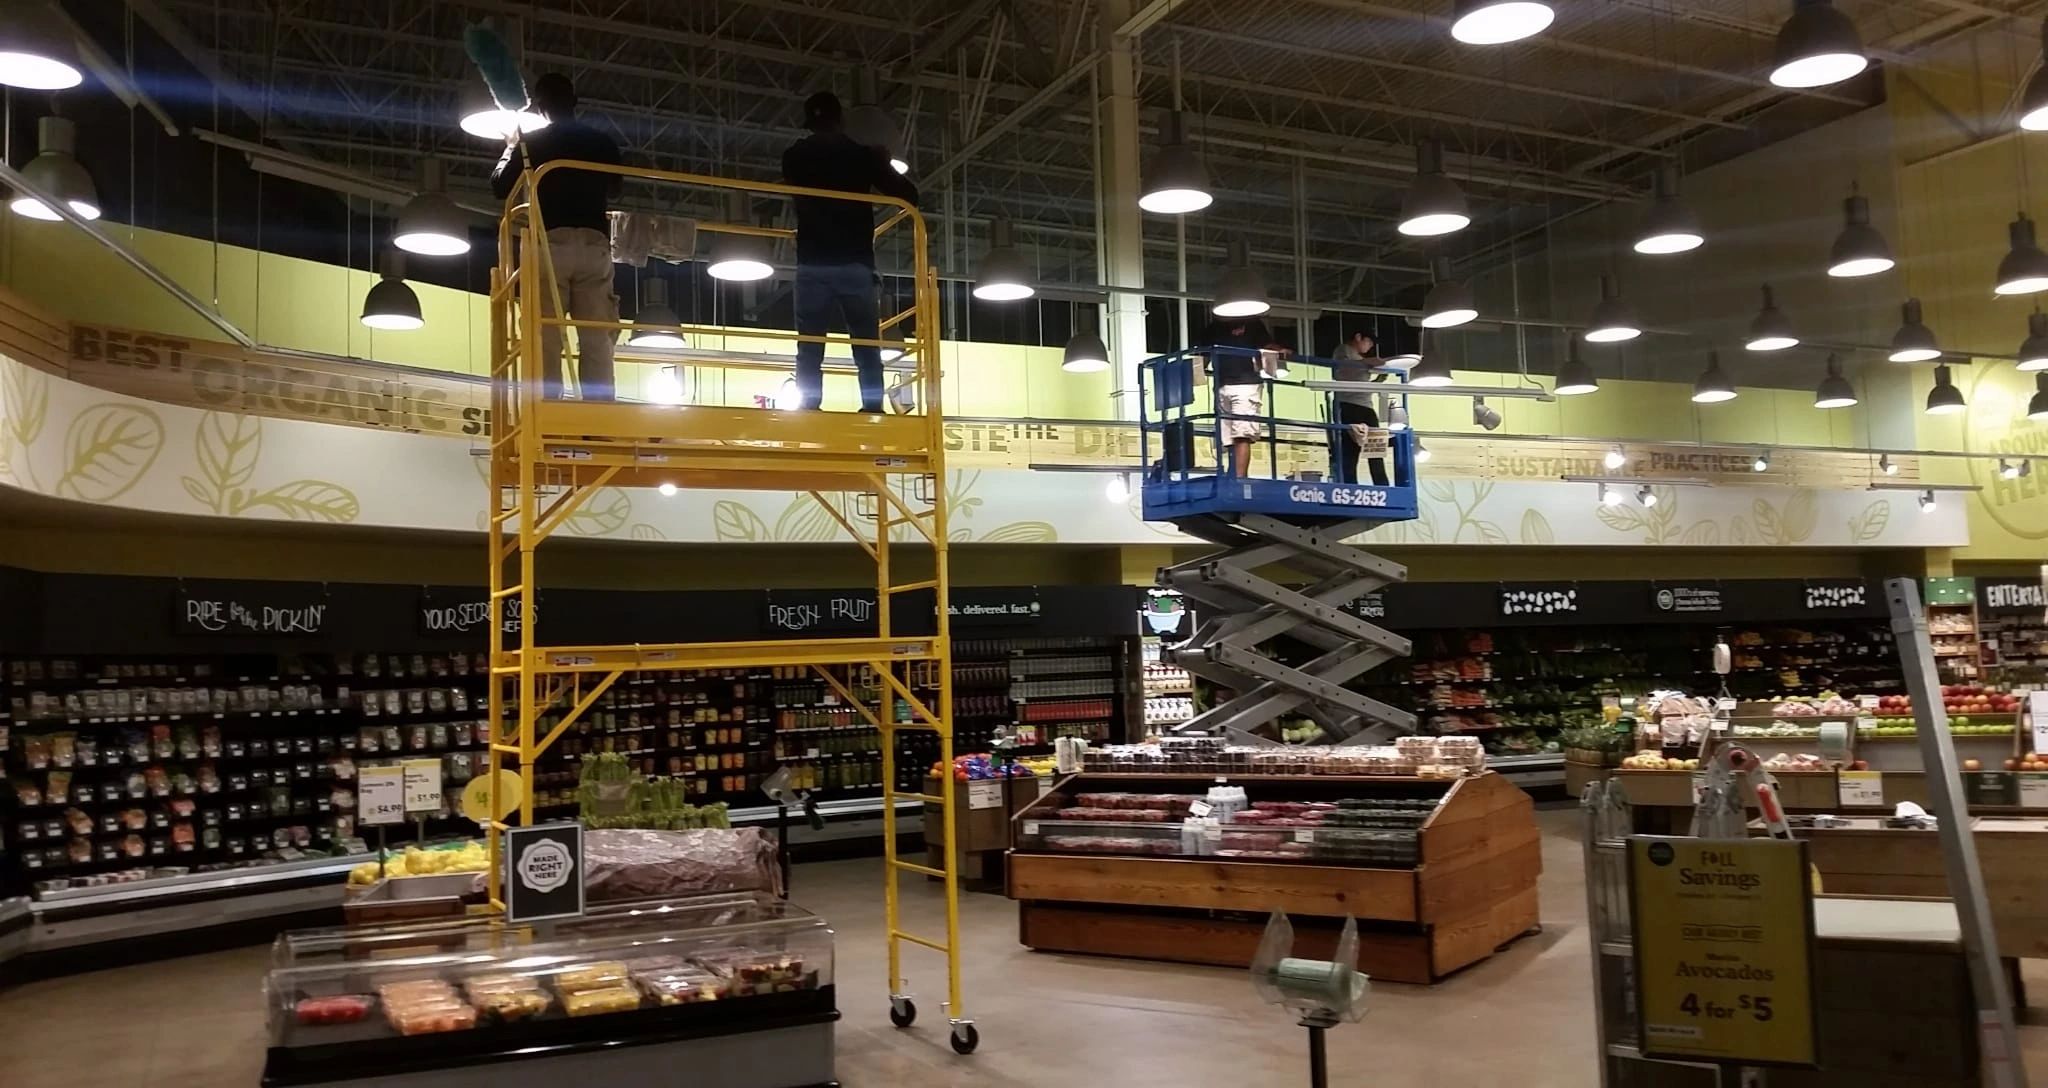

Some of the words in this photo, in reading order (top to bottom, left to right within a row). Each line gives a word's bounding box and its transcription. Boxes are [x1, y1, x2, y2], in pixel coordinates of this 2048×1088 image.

[73, 325, 190, 374] BEST
[191, 357, 448, 431] ORGANIC
[1013, 423, 1060, 440] THE
[1650, 451, 1753, 474] PRACTICES
[1290, 485, 1327, 503] Genie
[1331, 487, 1387, 507] GS-2632
[187, 599, 228, 631] RIPE
[263, 604, 326, 632] PICKIN'
[423, 607, 470, 632] YOUR
[769, 604, 823, 630] FRESH
[831, 598, 876, 622] FRUIT
[963, 604, 1009, 615] delivered.
[1010, 603, 1031, 614] fast.
[528, 862, 563, 873] RIGHT
[533, 855, 560, 863] MADE
[1680, 867, 1761, 891] Savings
[1674, 961, 1775, 981] Avocados
[1681, 993, 1701, 1017] 4
[1705, 1001, 1736, 1019] for
[1737, 994, 1774, 1022] $5
